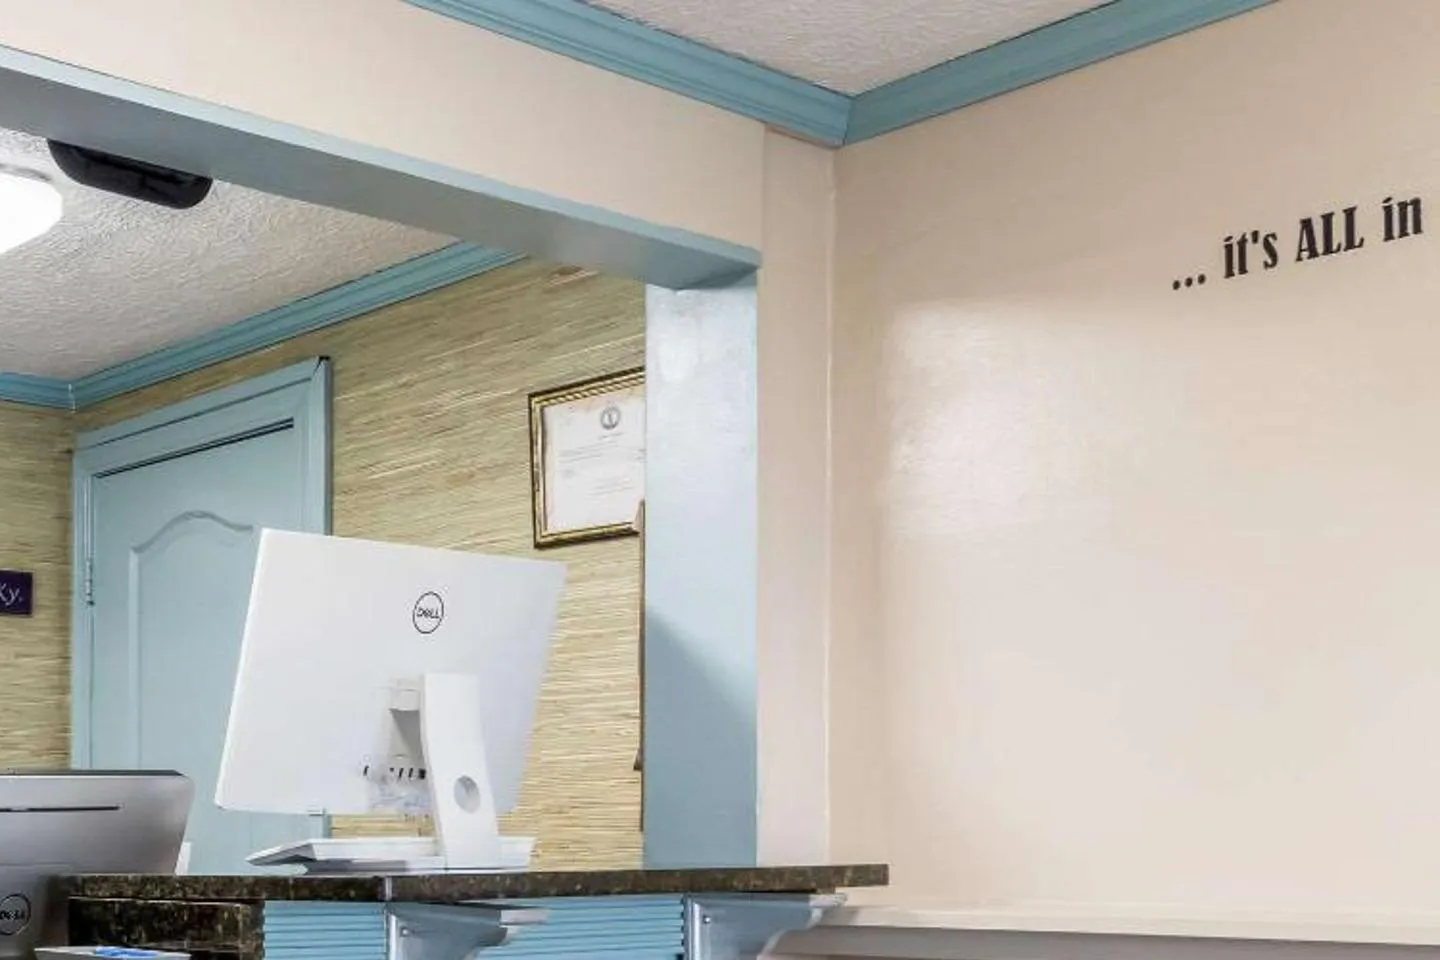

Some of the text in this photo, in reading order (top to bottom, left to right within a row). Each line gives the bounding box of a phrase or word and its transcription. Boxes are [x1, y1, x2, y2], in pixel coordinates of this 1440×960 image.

[1223, 229, 1279, 279] it's
[1295, 205, 1365, 262] ALL
[1382, 196, 1424, 242] in
